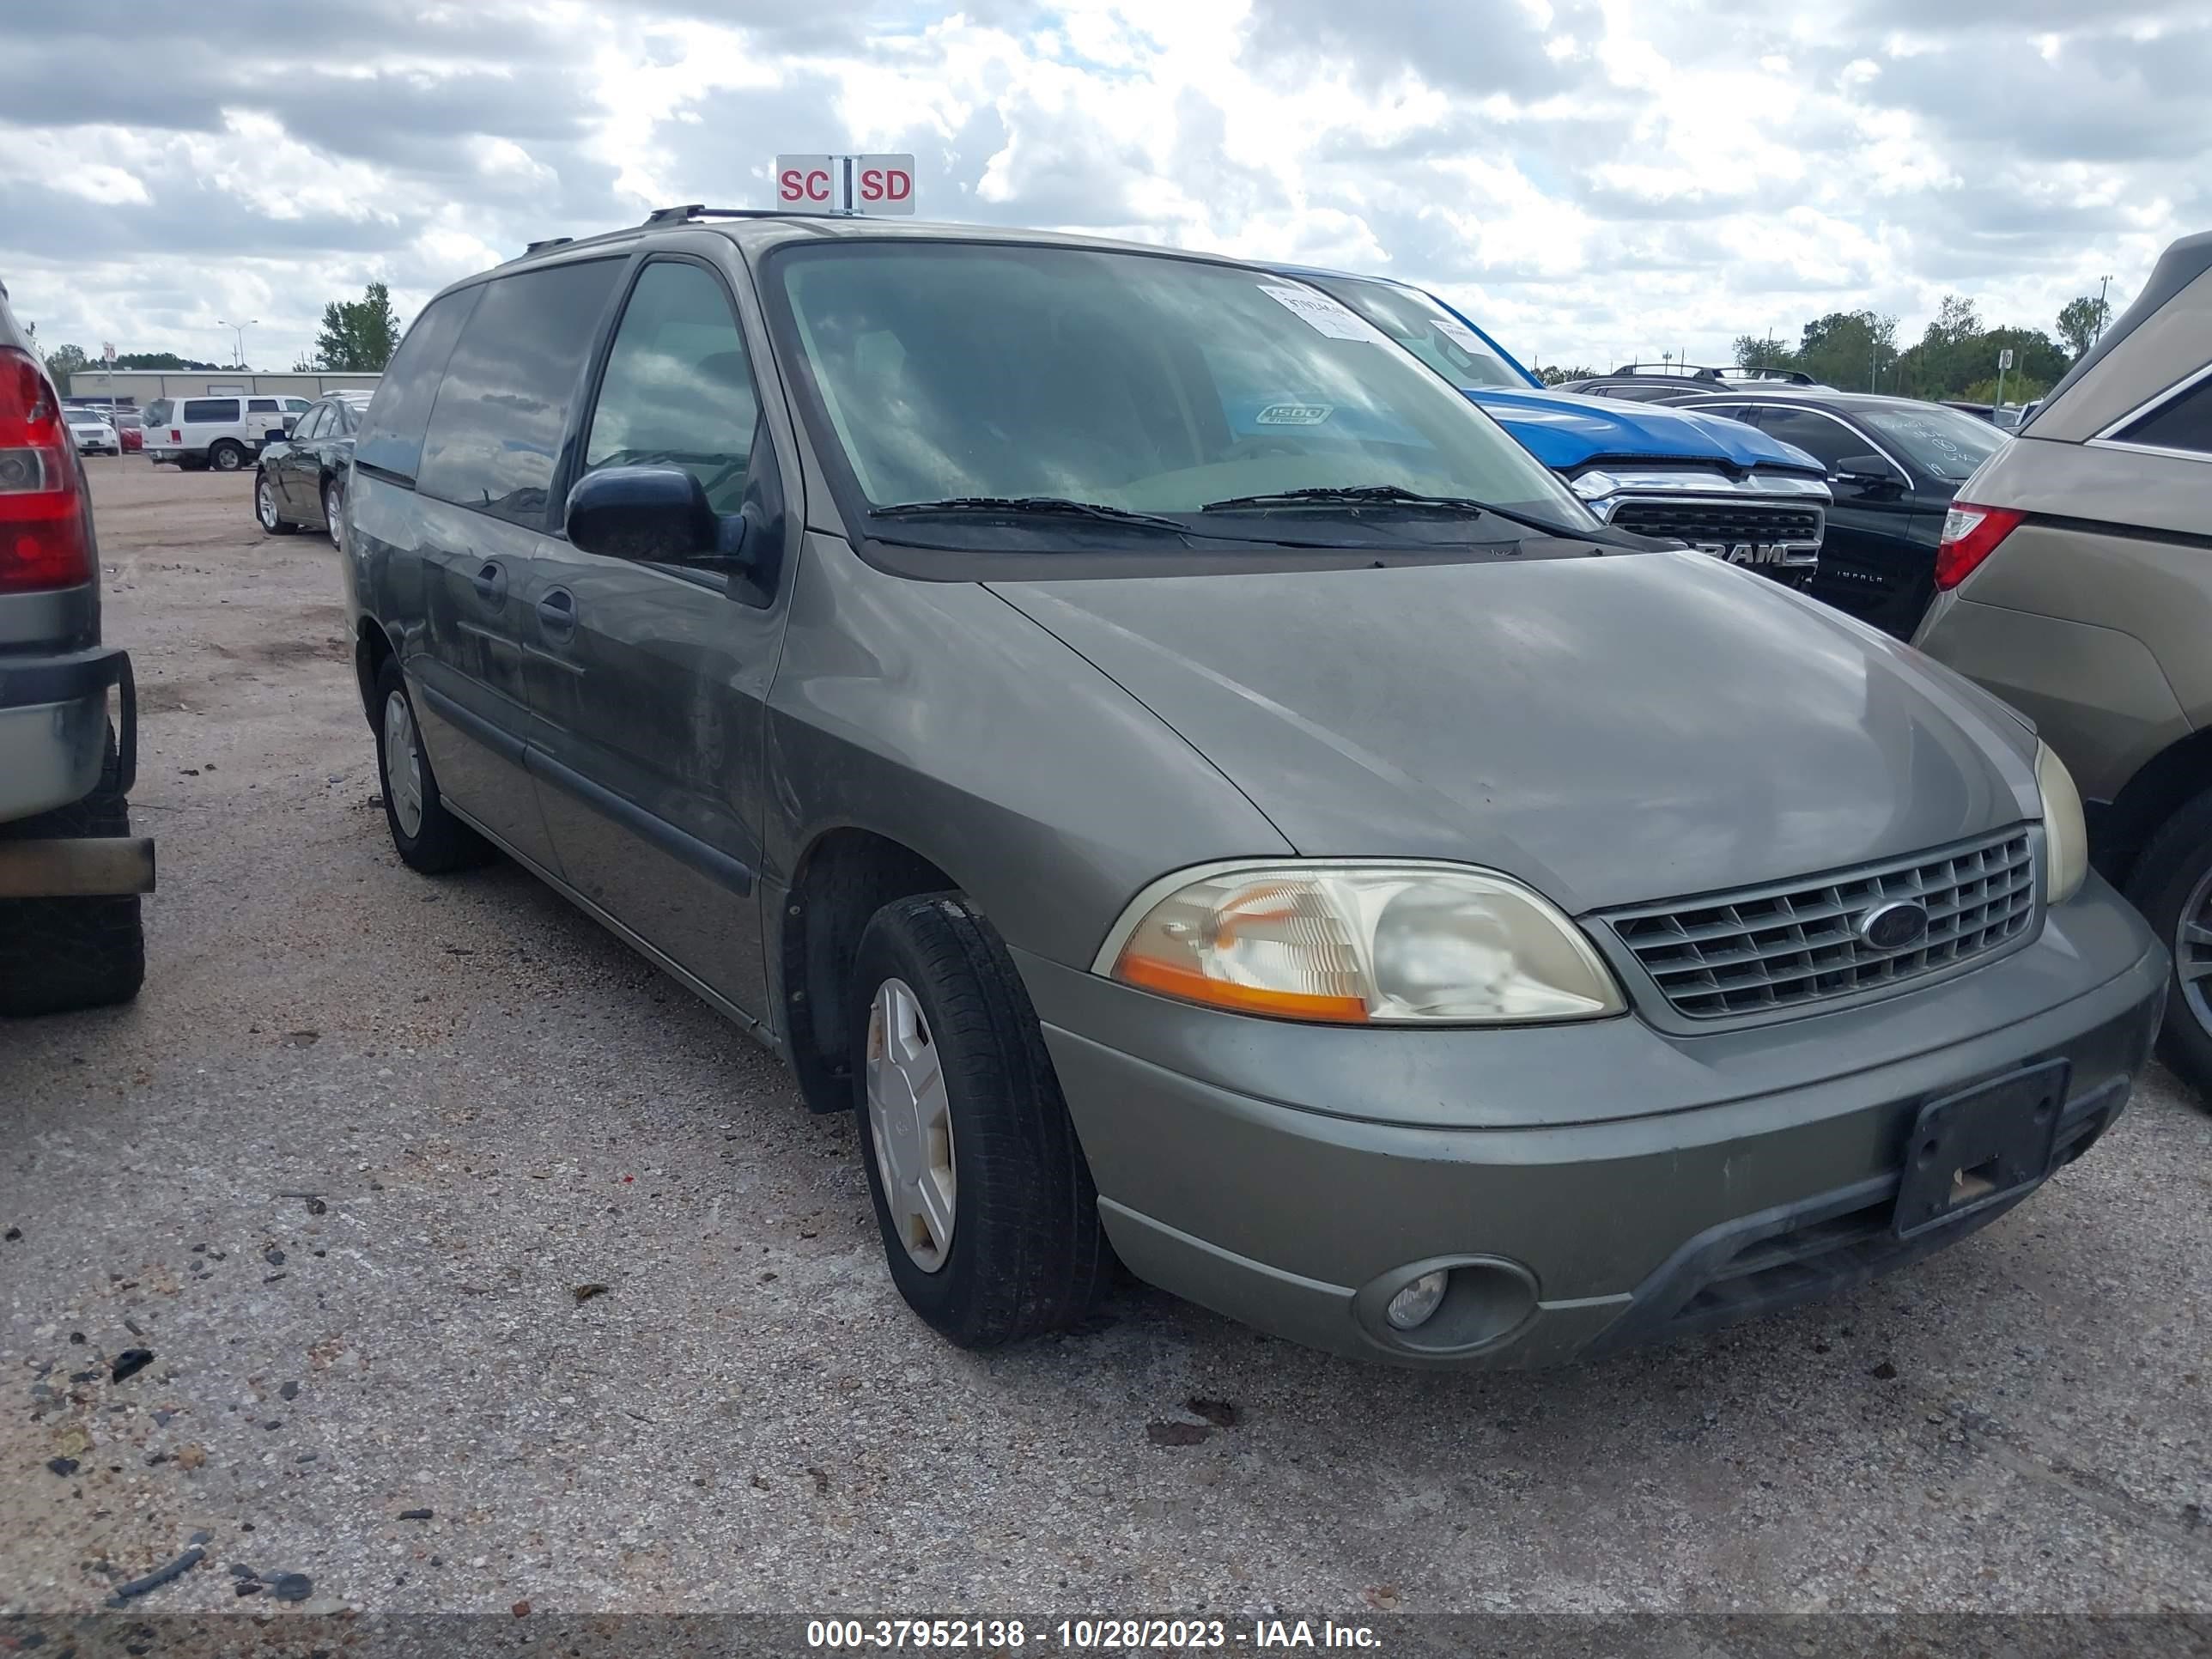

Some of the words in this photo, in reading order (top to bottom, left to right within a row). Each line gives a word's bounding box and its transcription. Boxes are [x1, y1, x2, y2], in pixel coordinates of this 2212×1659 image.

[781, 170, 830, 201] SC
[861, 170, 911, 201] SD
[1695, 544, 1784, 564] RAM
